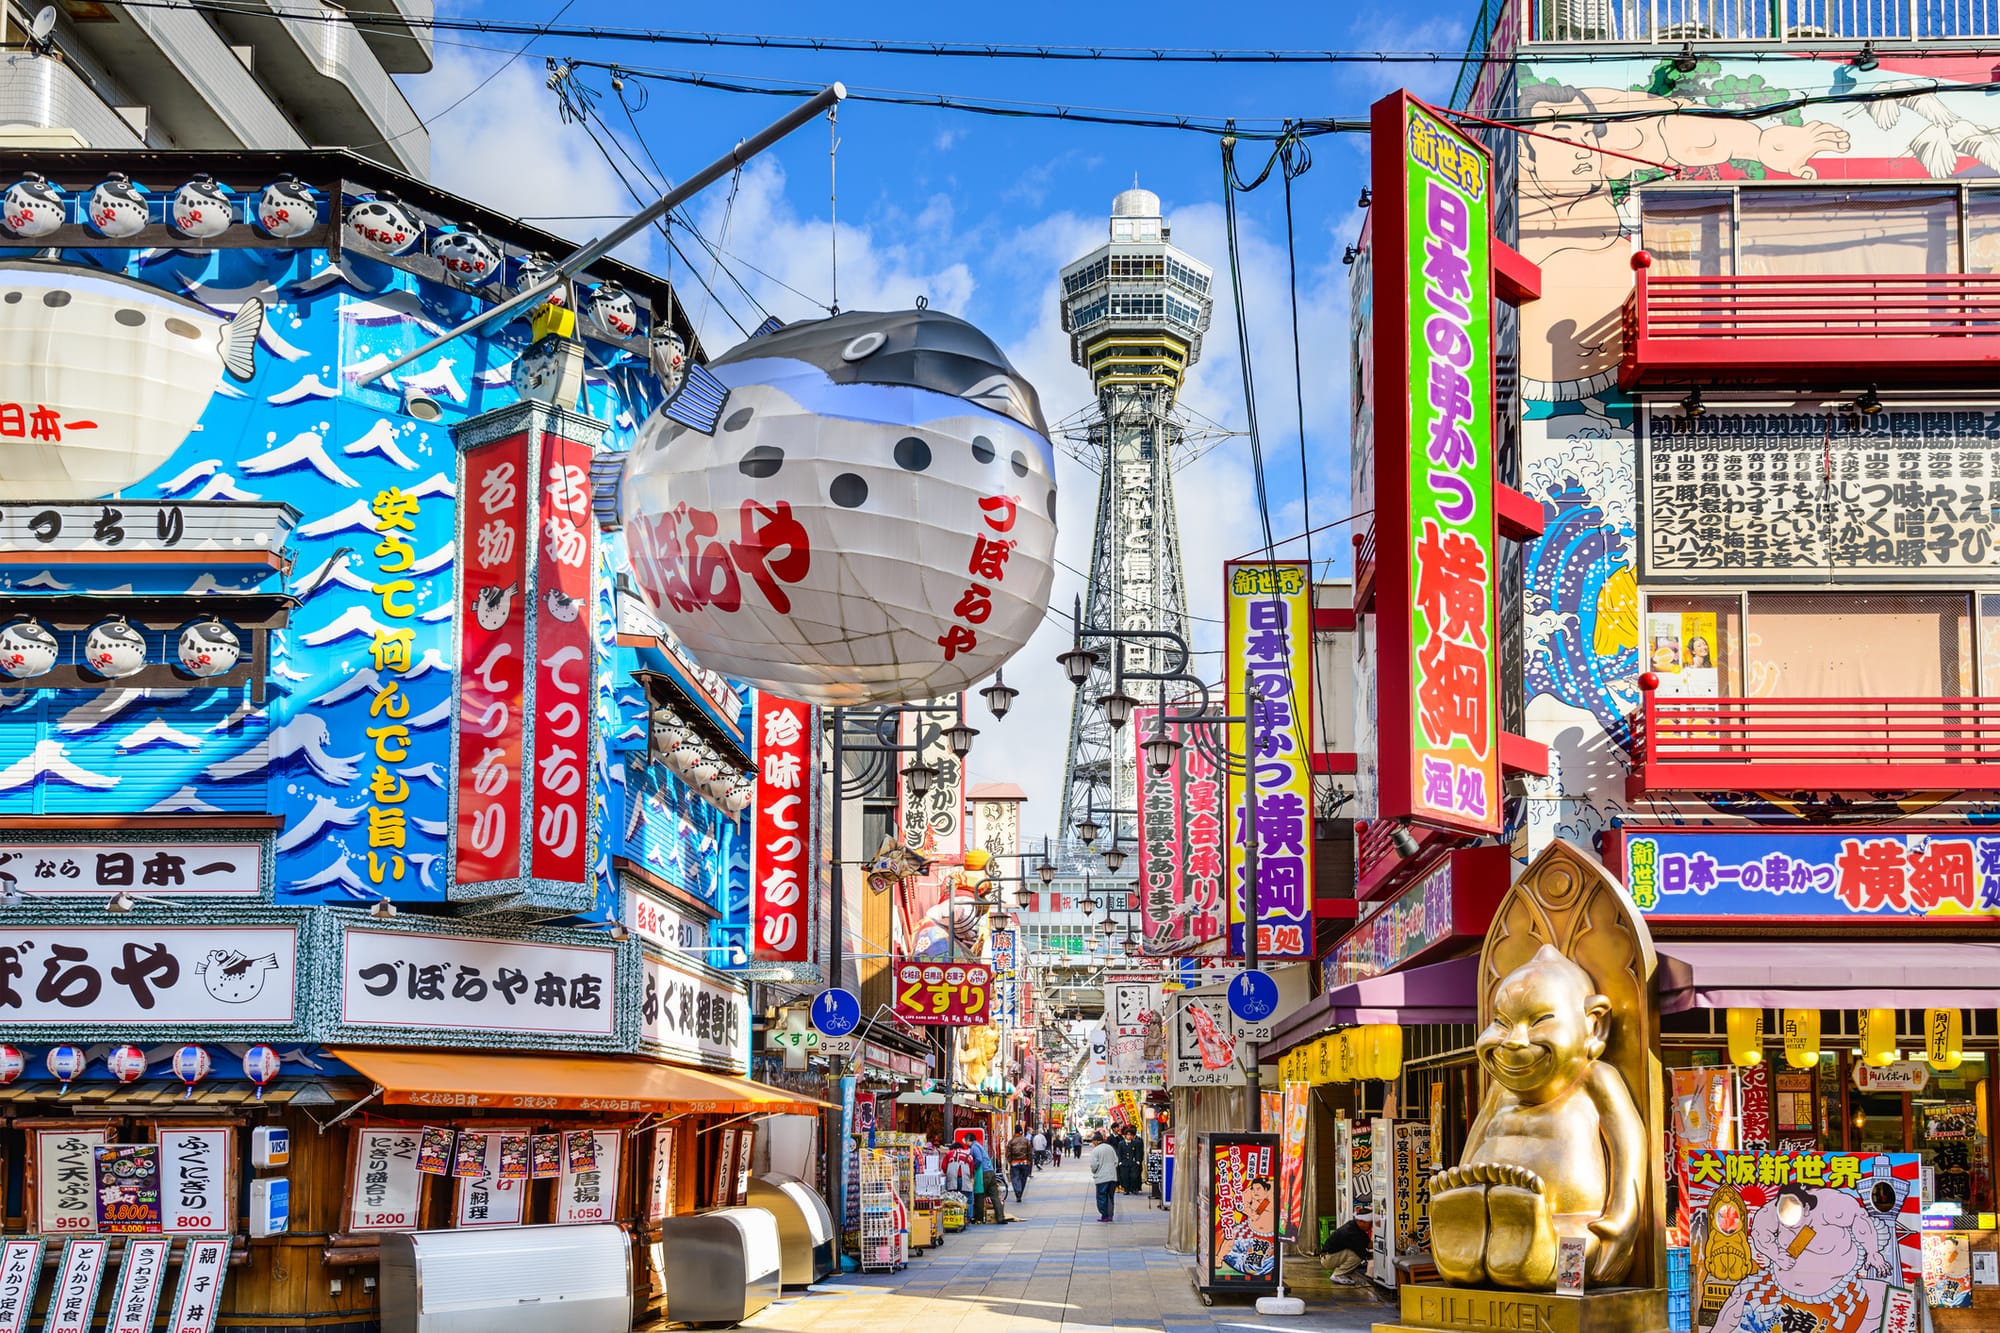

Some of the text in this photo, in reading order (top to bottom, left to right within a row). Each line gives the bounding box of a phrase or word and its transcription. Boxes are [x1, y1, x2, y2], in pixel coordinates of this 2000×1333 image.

[1411, 114, 1483, 200] 新世界
[1423, 178, 1476, 524] 日本一の串かつ
[0, 403, 98, 441] 日本一
[1653, 453, 1671, 482] 変り種
[1677, 453, 1695, 482] 山の幸
[1701, 453, 1719, 482] 変り種
[1724, 453, 1742, 482] 海の幸
[1748, 453, 1766, 482] 変り種
[1771, 453, 1789, 482] 変り種
[1794, 453, 1811, 482] 変り種
[1865, 453, 1889, 480] 山の幸
[1898, 452, 1921, 480] 変り種
[1928, 452, 1952, 479] 海の幸
[1959, 452, 1983, 479] 海の幸
[477, 462, 515, 568] 名物
[545, 462, 587, 568] 名物
[1654, 484, 1677, 566] アスパラベーコン
[1677, 484, 1700, 568] 豚アスパラ
[1700, 483, 1722, 567] 角煮の串かつ
[1722, 484, 1746, 566] いわし梅肉
[1746, 482, 1770, 567] うずら玉子
[1769, 483, 1794, 567] チーズしそ巻
[1792, 482, 1817, 566] もちいそべ
[1839, 481, 1865, 567] じゃが芋
[1862, 484, 1896, 564] つくね
[1893, 481, 1926, 566] 味噌豚
[1926, 484, 1959, 563] 穴子
[1958, 484, 1995, 563] えび
[938, 494, 1021, 661] づぼらや
[1234, 568, 1303, 595] 新世界
[1416, 519, 1488, 760] 横綱
[366, 486, 420, 884] 安うて何んでも旨い
[1247, 601, 1293, 788] 日本一の串かつ
[472, 643, 511, 858] てっちり
[539, 645, 585, 858] てっちり
[1425, 755, 1485, 817] 酒処
[762, 707, 803, 952] 珍味てっちり
[927, 758, 958, 833] 串かつ
[1237, 793, 1305, 921] 横綱
[1631, 840, 1658, 908] 新世界
[1662, 855, 1835, 893] 日本一の串かつ
[1838, 841, 1976, 909] 横綱
[358, 960, 603, 1010] づぼらや本店
[642, 972, 739, 1049] ふぐ料理専門
[900, 982, 985, 1015] くすり
[774, 1031, 819, 1046] くすり
[821, 1041, 850, 1051] 9-22
[1238, 1028, 1268, 1038] 9-22
[1933, 1011, 1949, 1061] 角ハイボール
[1109, 1074, 1162, 1085] 宴会予約受付中
[1869, 1070, 1911, 1081] 角ハイボール
[57, 1137, 90, 1210] ふぐ天ぷら
[178, 1136, 210, 1210] ふぐにぎり
[271, 1141, 286, 1153] VISA
[364, 1136, 392, 1207] にぎり盛合せ
[393, 1136, 416, 1160] ふぐ
[1692, 1153, 1863, 1188] 大阪新世界
[56, 1217, 90, 1228] 950
[104, 1204, 149, 1220] 3,800
[177, 1216, 211, 1228] 800
[0, 1248, 29, 1323] とんかつ定食
[63, 1248, 94, 1322] とんかつ定食
[124, 1248, 155, 1322] きつねうどん定食
[187, 1248, 218, 1321] 親子丼
[1420, 1295, 1555, 1333] BILLIKEN
